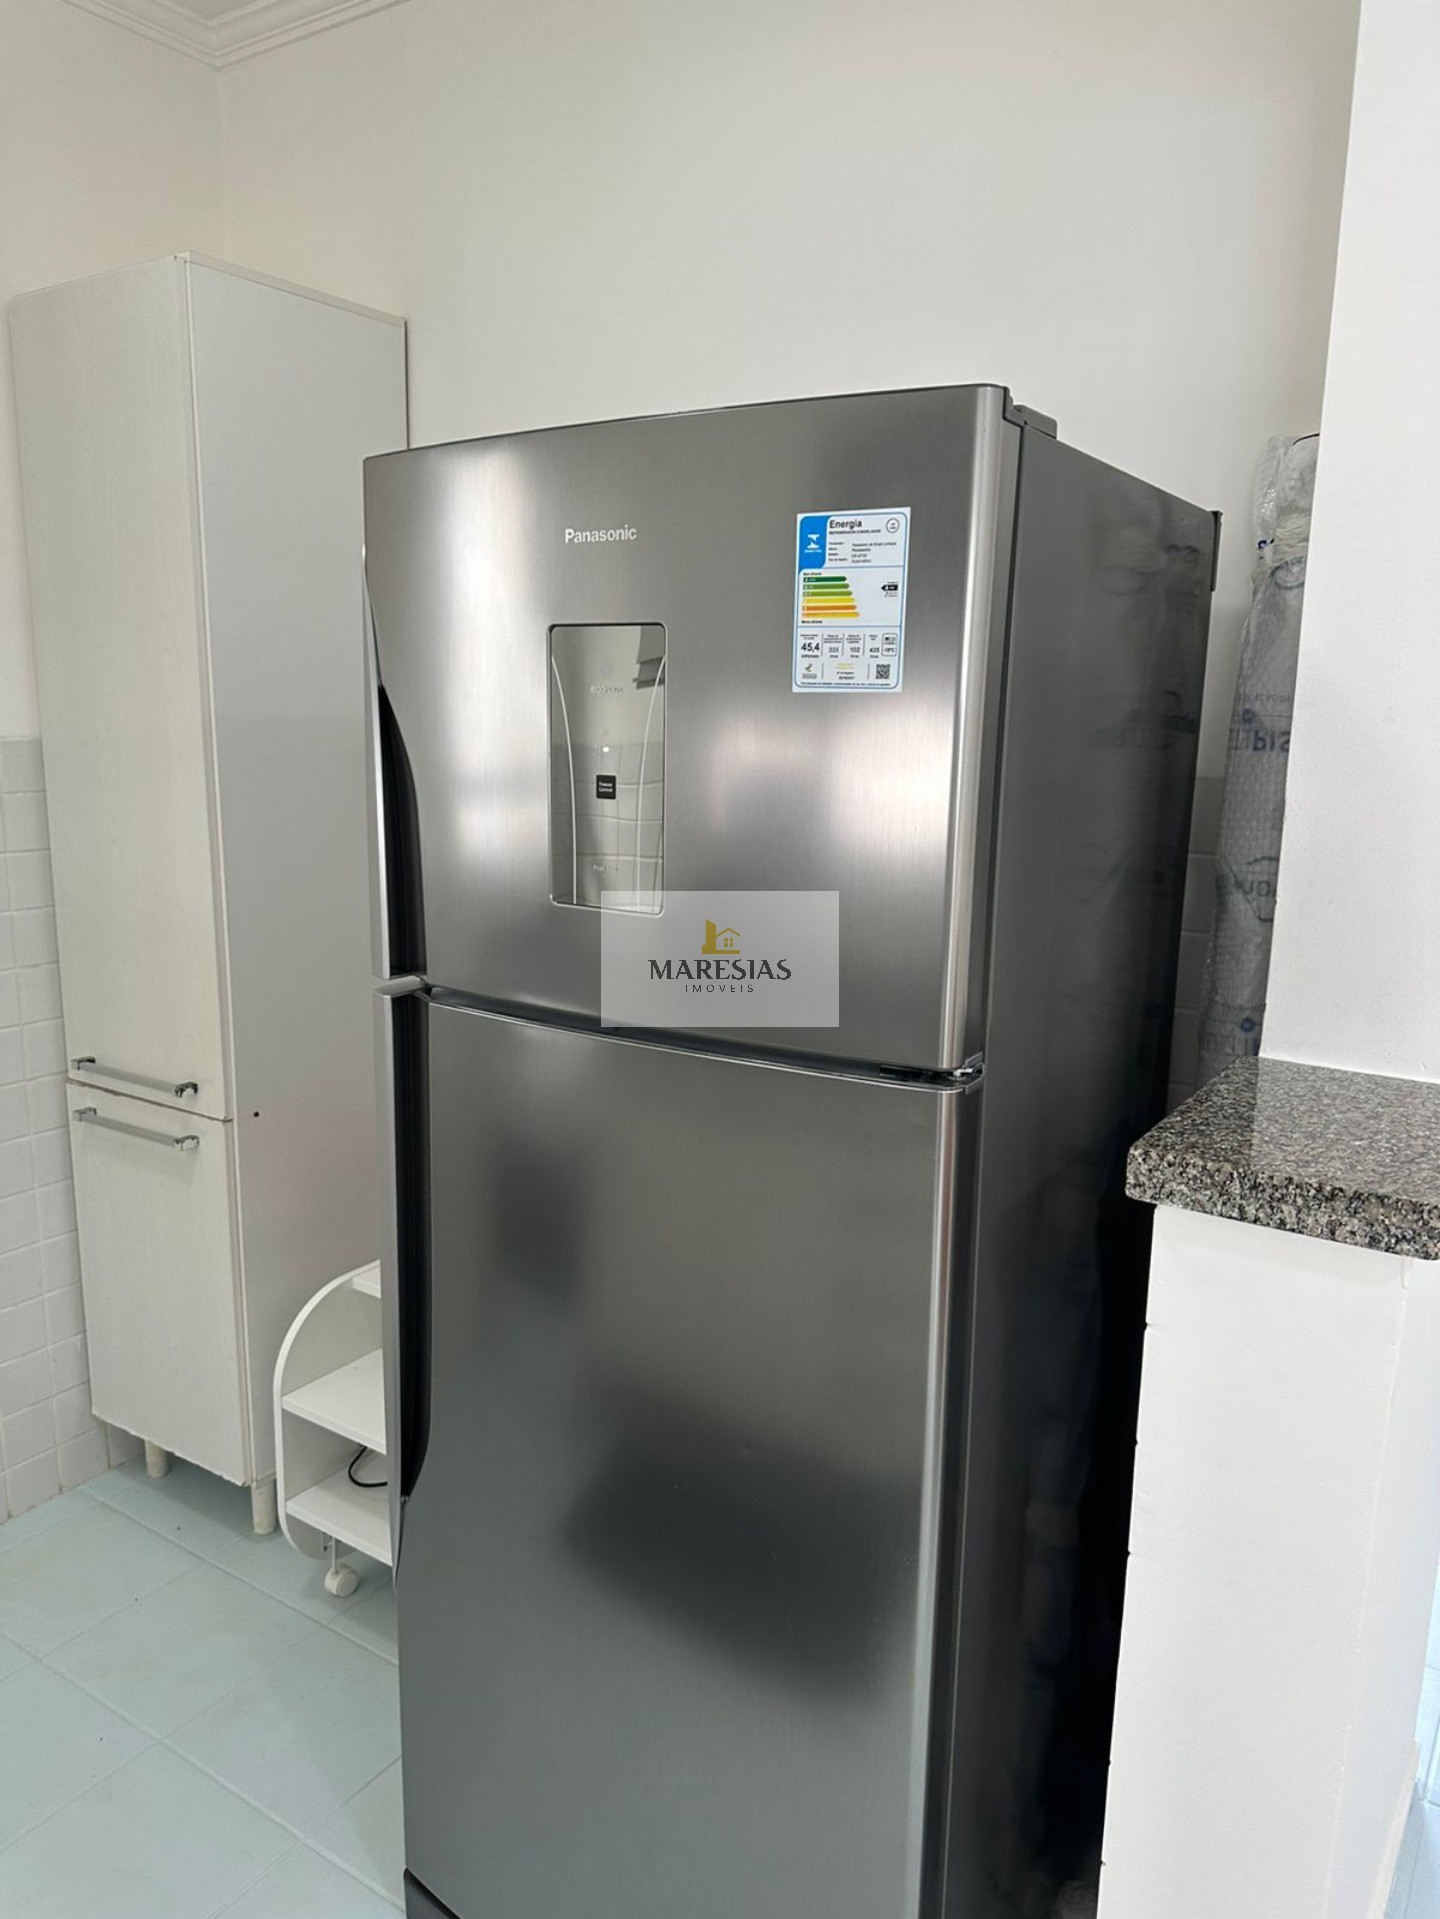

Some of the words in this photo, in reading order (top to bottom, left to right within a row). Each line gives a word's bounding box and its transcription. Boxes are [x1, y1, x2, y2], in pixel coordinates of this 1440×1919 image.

[829, 519, 862, 529] Energia
[564, 524, 638, 543] Panasonic
[801, 643, 820, 653] 45,4
